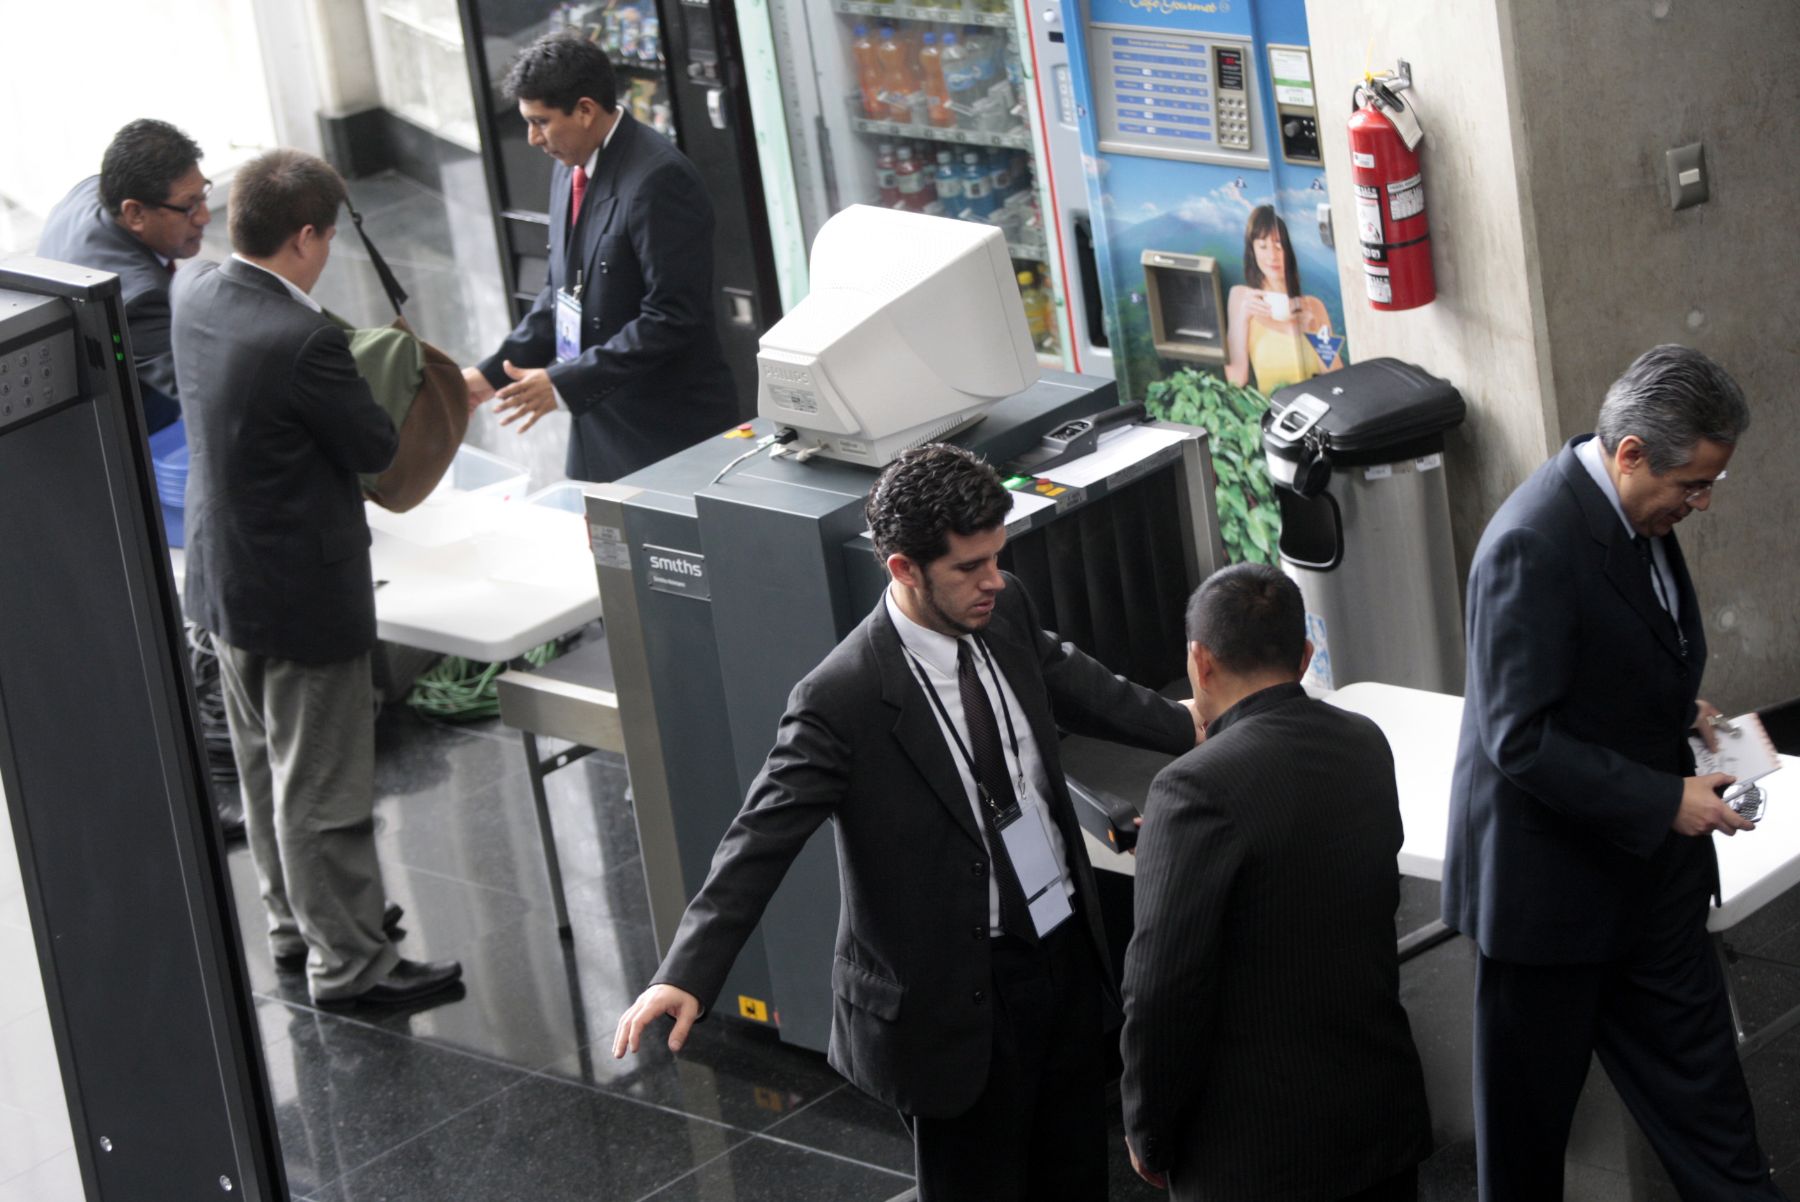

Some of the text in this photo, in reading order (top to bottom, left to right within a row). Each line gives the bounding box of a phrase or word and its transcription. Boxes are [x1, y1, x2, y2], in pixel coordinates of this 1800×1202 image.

[1316, 325, 1330, 344] 4
[763, 364, 809, 385] PHILIPS
[650, 555, 702, 577] smiths
